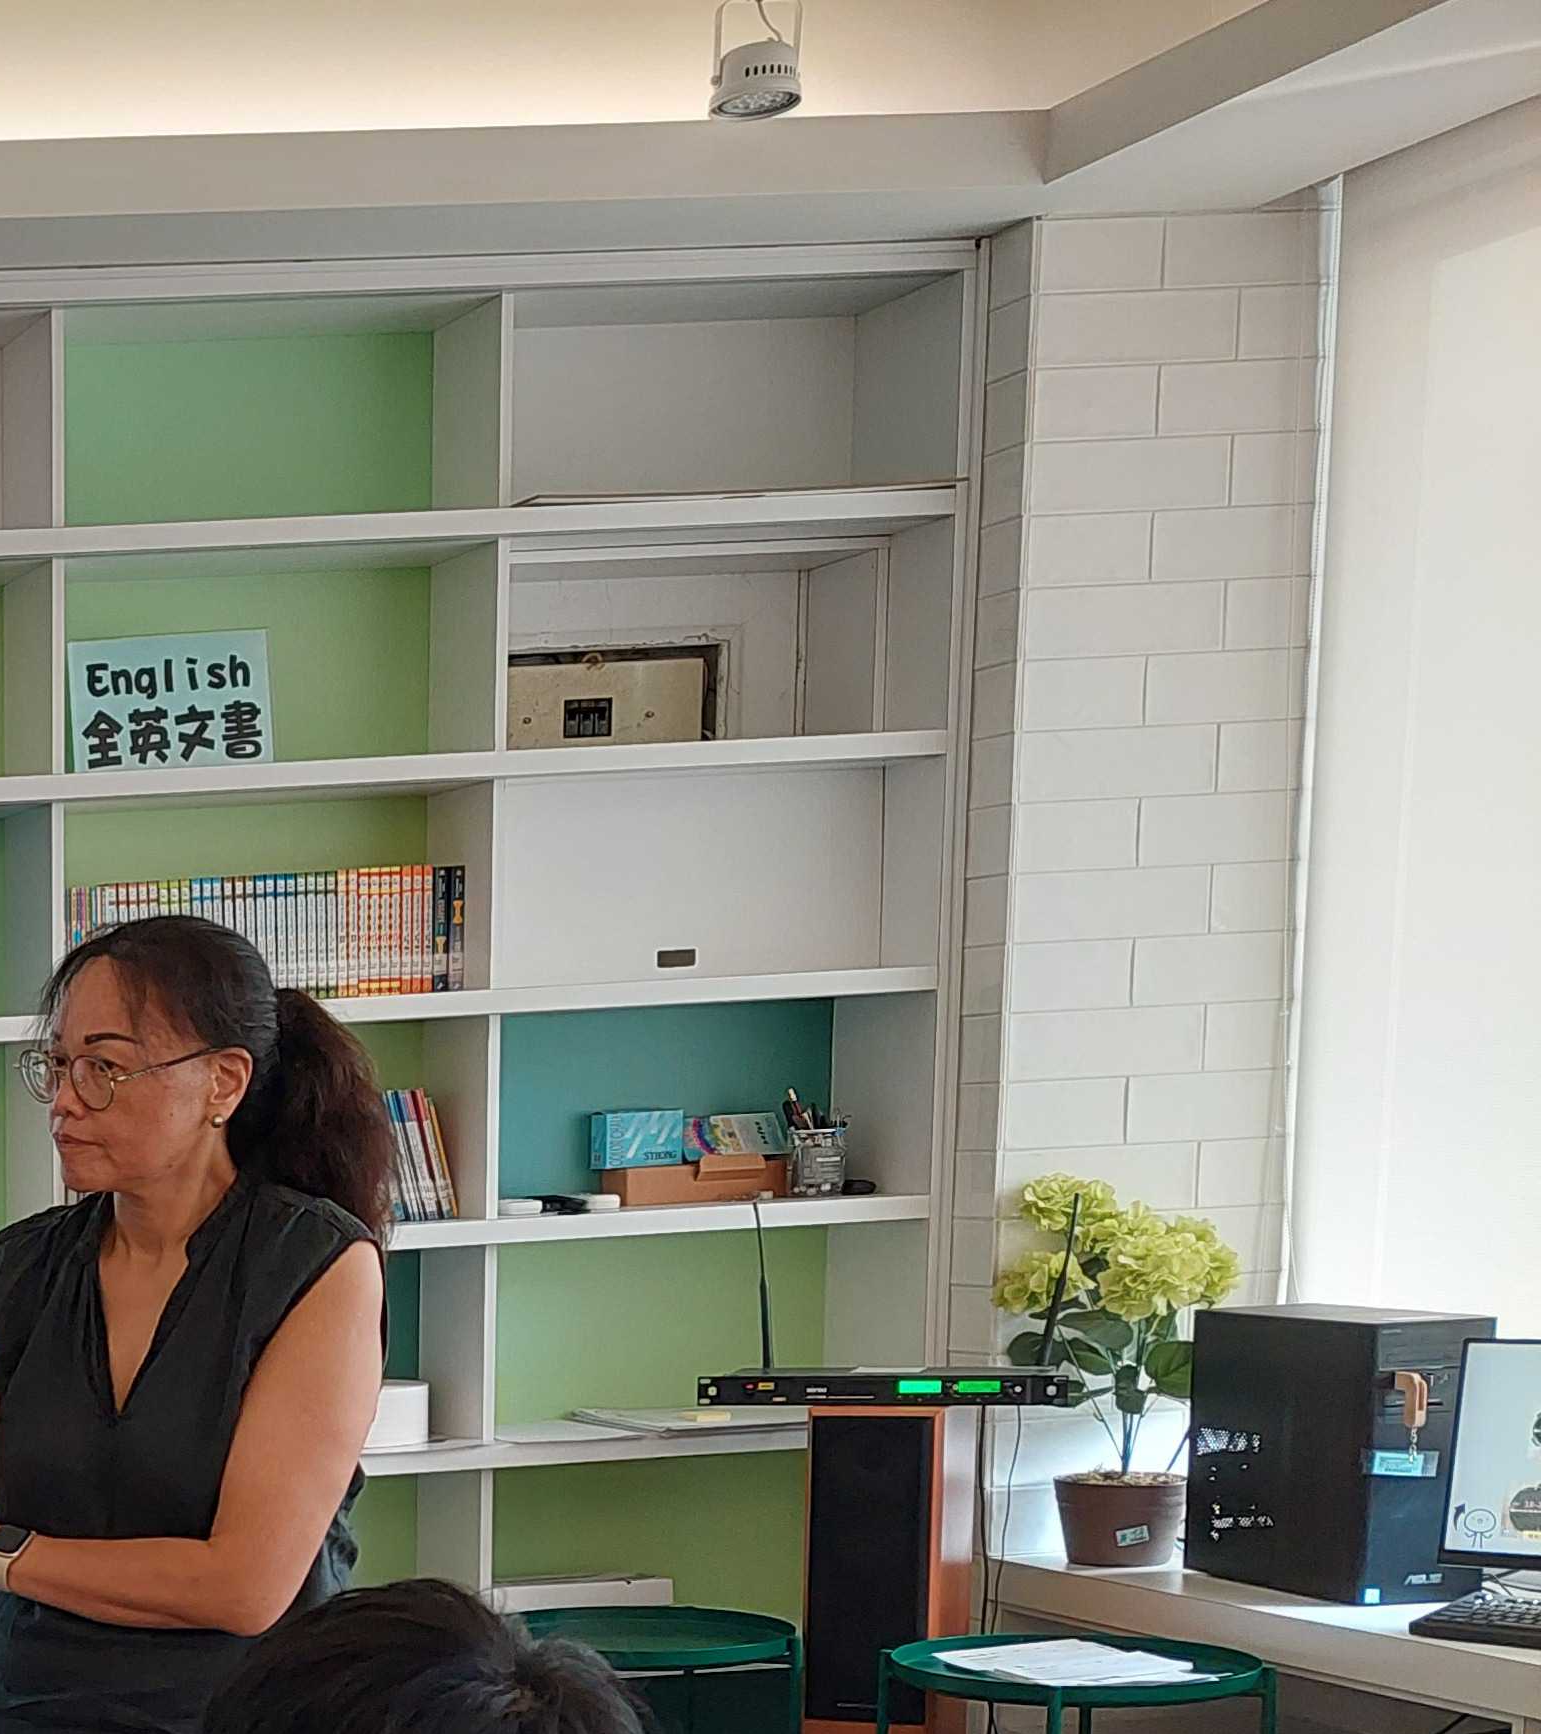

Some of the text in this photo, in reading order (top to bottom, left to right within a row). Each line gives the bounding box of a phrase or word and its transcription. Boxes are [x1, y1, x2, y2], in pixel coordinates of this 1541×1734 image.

[86, 654, 251, 700] English
[82, 700, 262, 769] 全英文書
